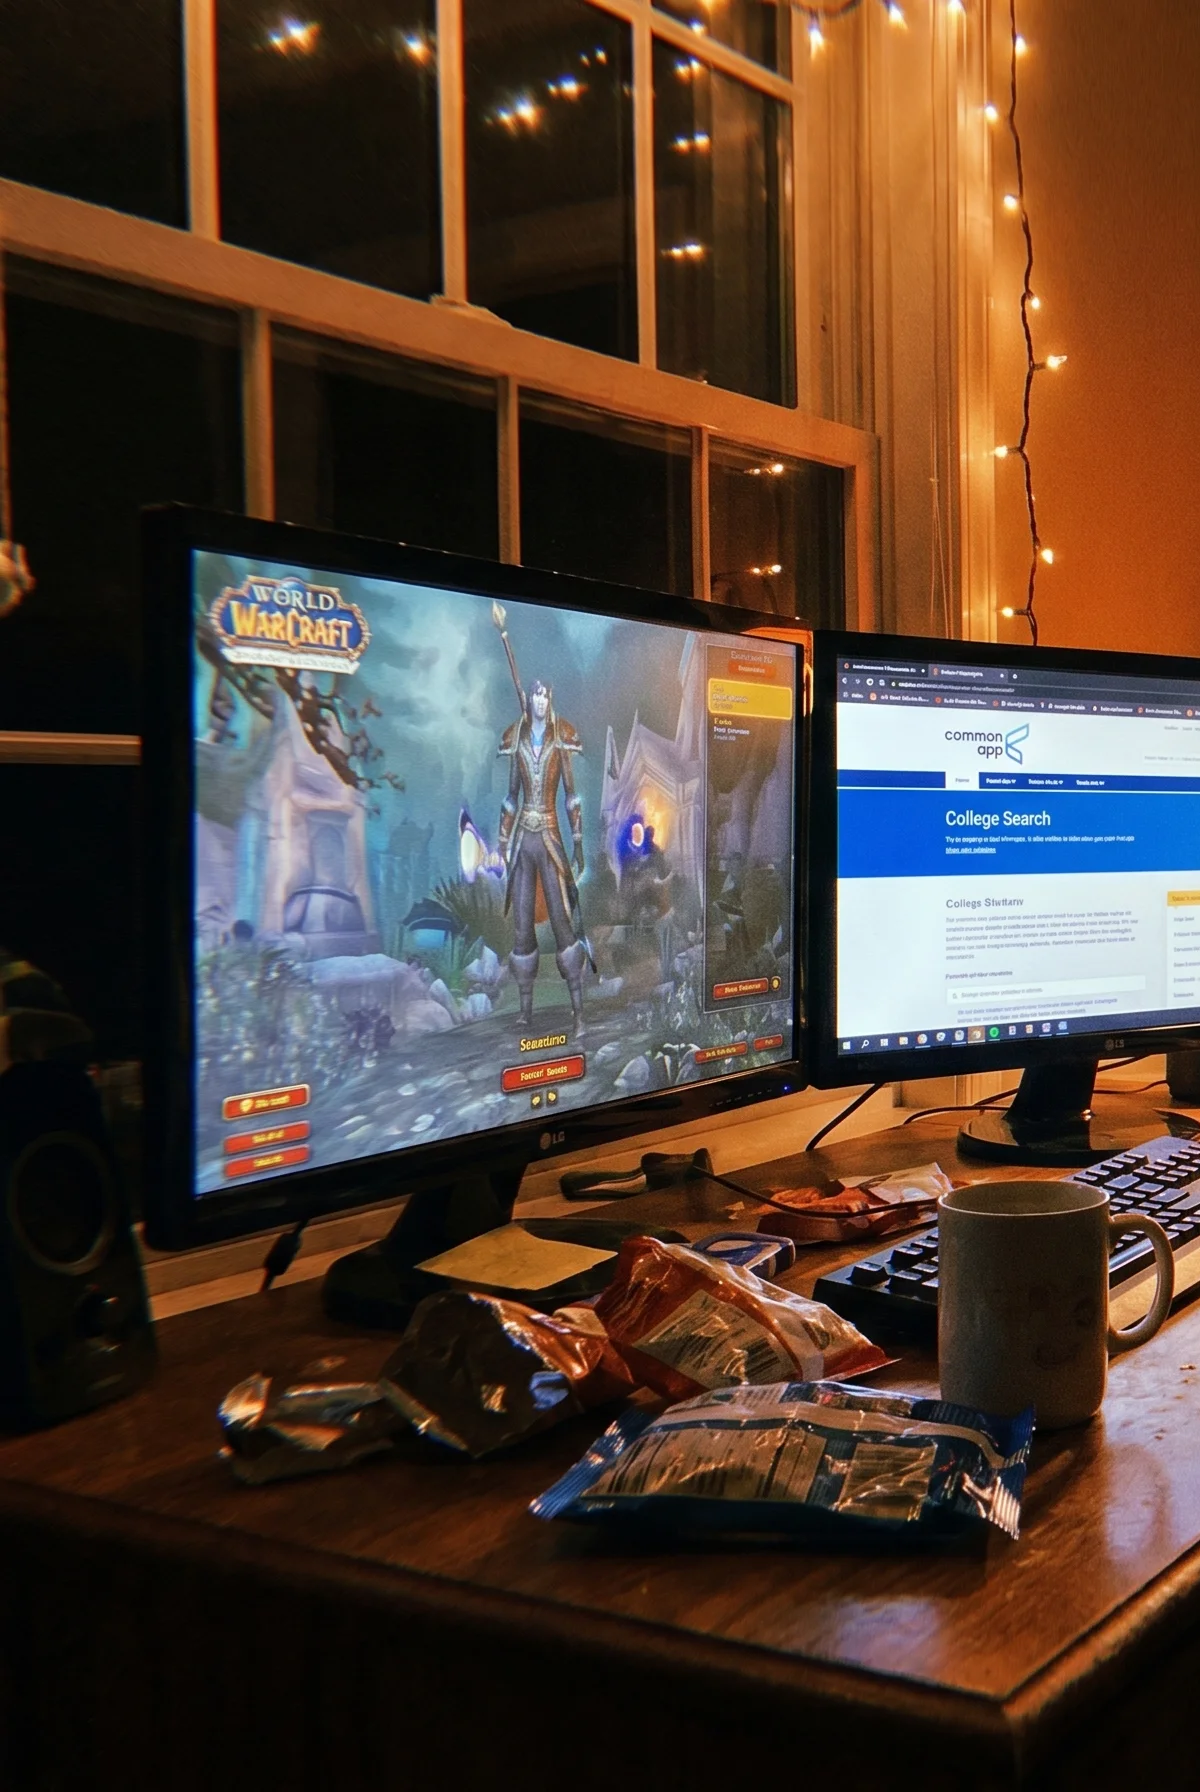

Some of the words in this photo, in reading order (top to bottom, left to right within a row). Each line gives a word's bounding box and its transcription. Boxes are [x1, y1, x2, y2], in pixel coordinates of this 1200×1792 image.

[251, 584, 335, 613] WORLD
[944, 730, 1003, 743] common
[977, 745, 1003, 760] app
[945, 810, 1000, 830] College
[1003, 810, 1051, 827] Search
